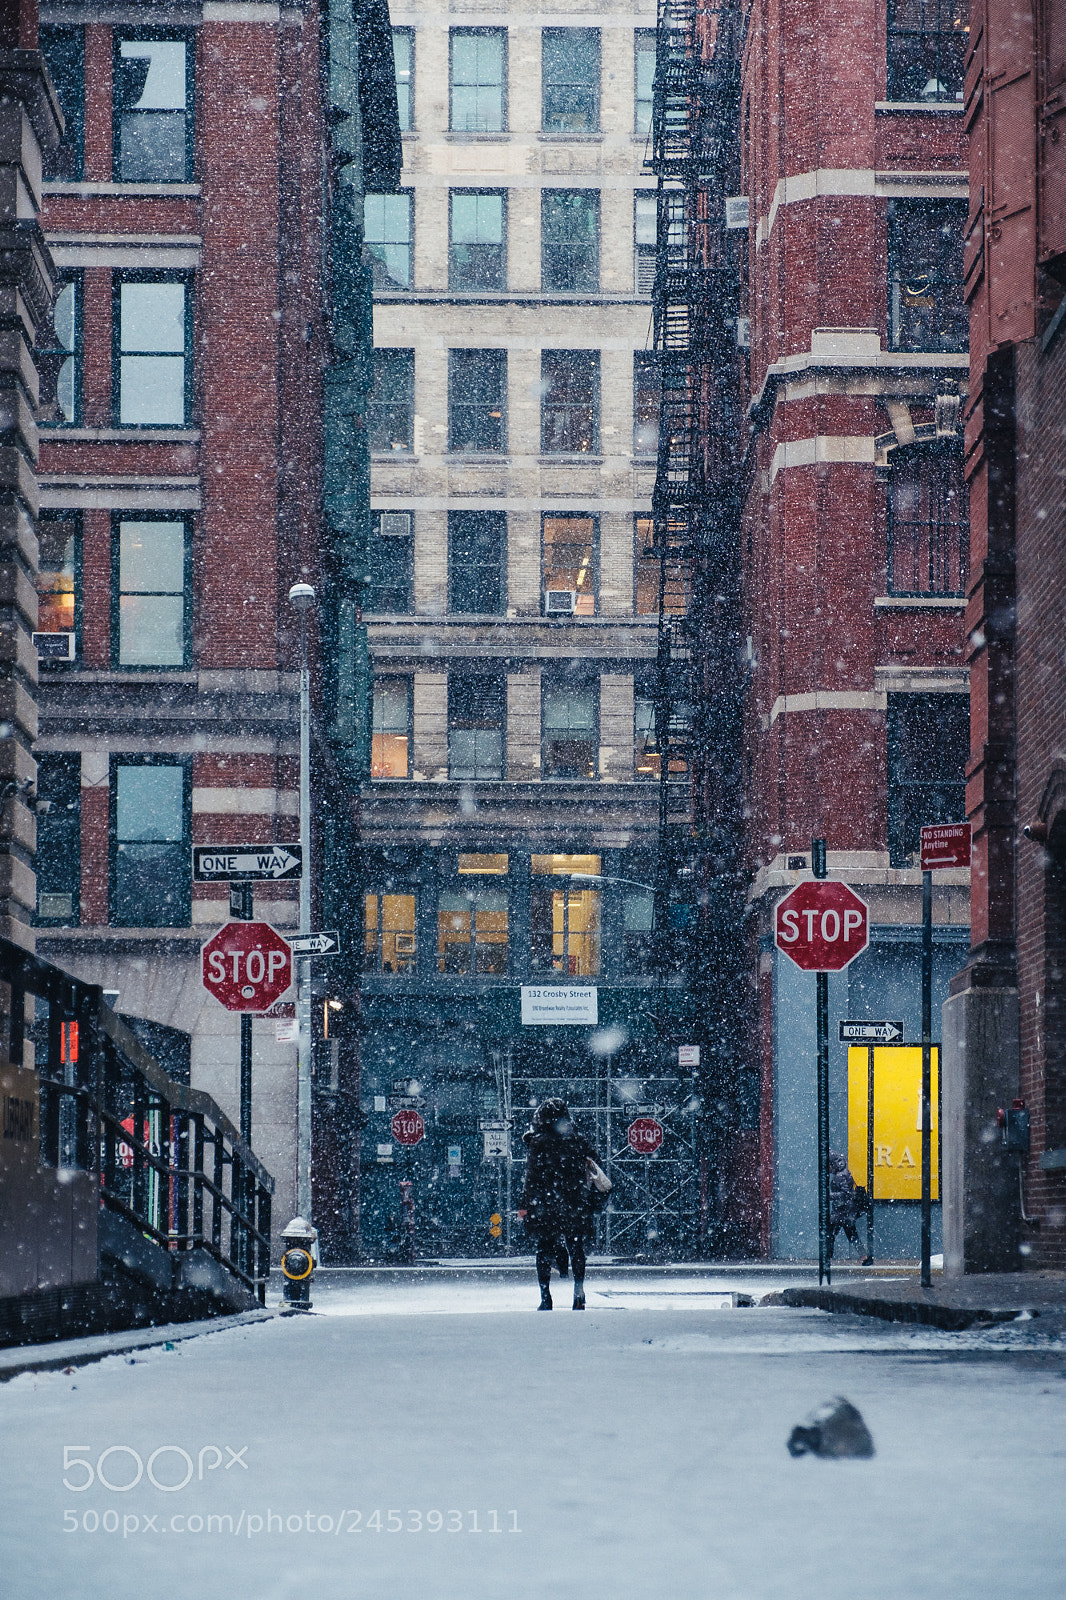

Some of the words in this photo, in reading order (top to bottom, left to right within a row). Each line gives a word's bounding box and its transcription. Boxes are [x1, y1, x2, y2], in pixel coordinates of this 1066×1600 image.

[923, 831, 932, 839] NO
[933, 828, 963, 838] STANDING
[923, 840, 948, 850] Anytime
[203, 856, 238, 871] ONE
[257, 855, 290, 870] WAY
[778, 909, 863, 943] STOP
[309, 939, 329, 949] WAY
[207, 950, 287, 983] STOP
[542, 990, 567, 998] Crosby
[848, 1027, 867, 1036] ONE
[874, 1027, 894, 1037] WAY
[392, 1120, 422, 1134] STOP
[630, 1129, 661, 1143] STOP
